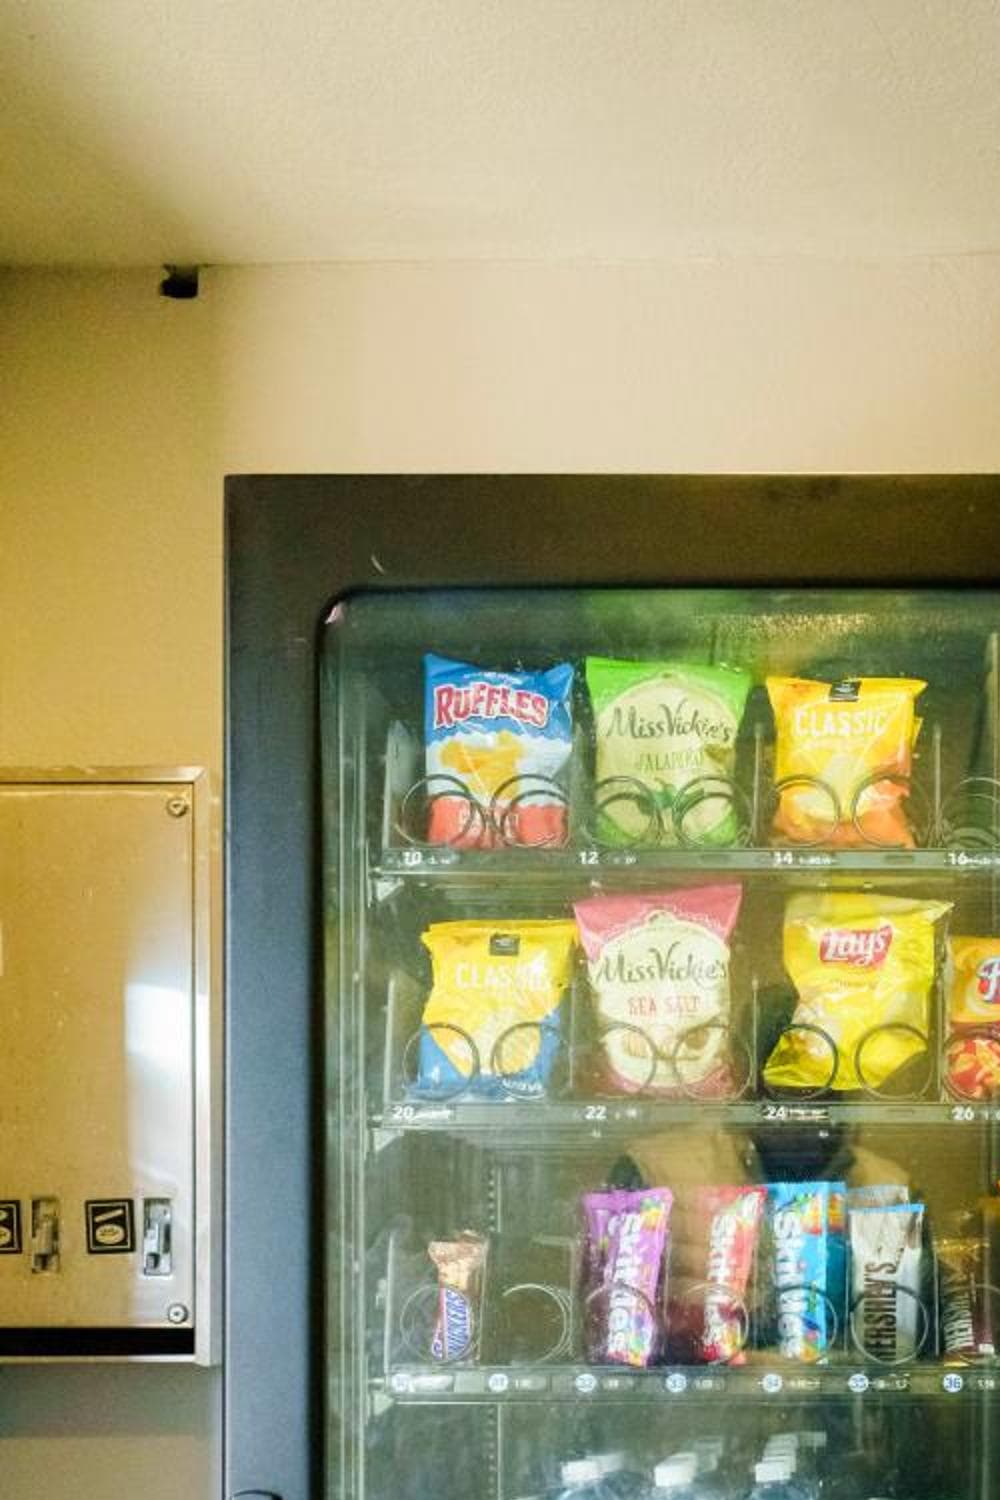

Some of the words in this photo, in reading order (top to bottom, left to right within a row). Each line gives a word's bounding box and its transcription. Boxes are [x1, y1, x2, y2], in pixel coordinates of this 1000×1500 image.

[435, 681, 548, 728] RUFFLES
[794, 707, 888, 737] CLASSIC
[579, 851, 600, 865] 12
[584, 1105, 608, 1120] 22
[950, 1106, 971, 1120] 26
